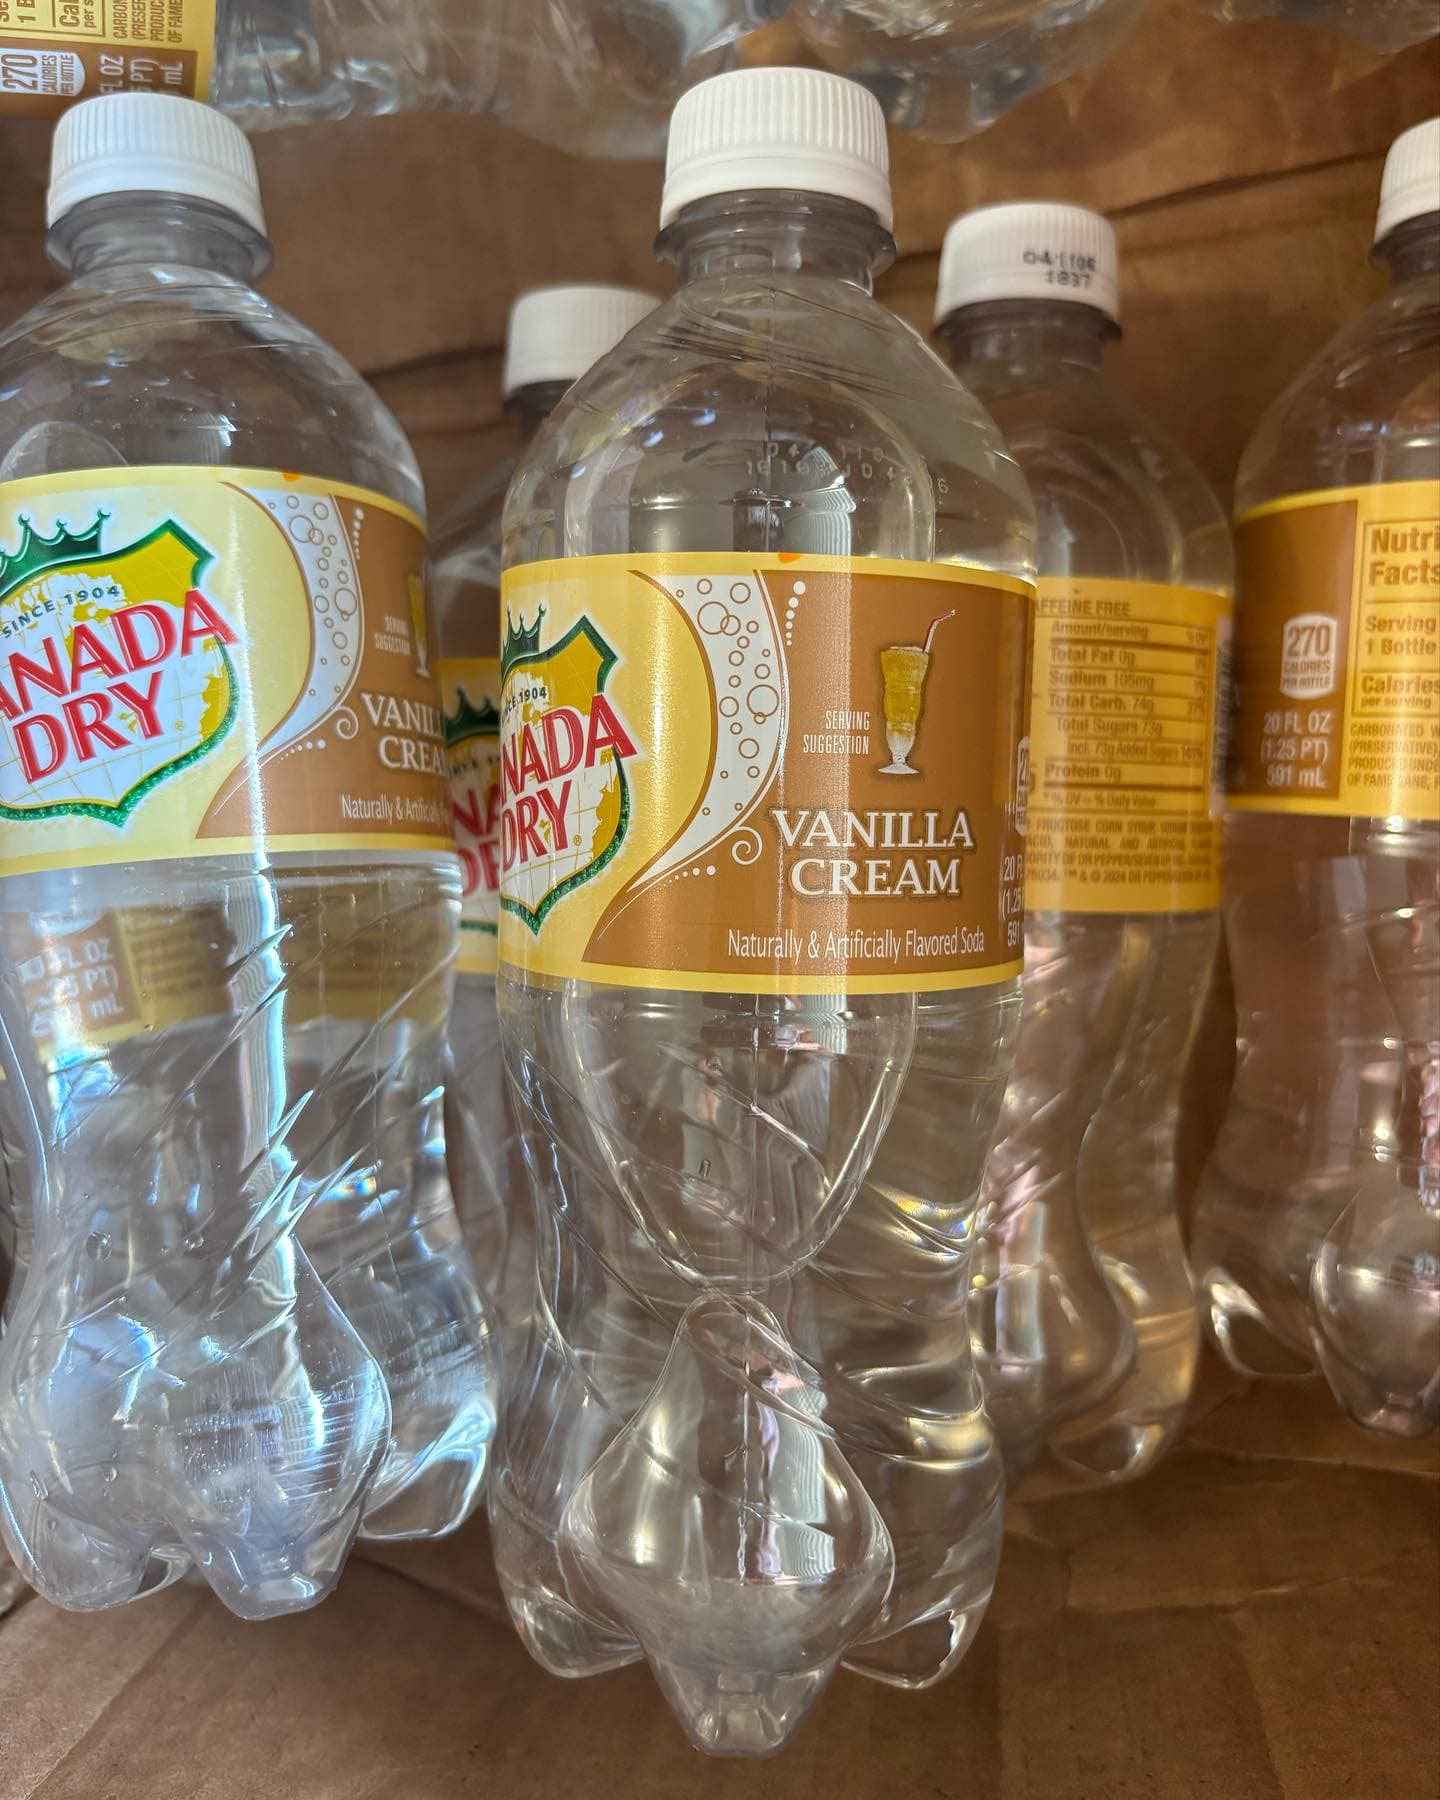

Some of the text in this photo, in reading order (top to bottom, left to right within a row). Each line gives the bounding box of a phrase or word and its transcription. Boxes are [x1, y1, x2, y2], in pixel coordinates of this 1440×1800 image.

[84, 9, 98, 29] per
[167, 29, 183, 43] OF
[1, 53, 38, 91] 270
[41, 55, 57, 93] CALORIES
[60, 54, 74, 95] PER BOTTLE
[100, 54, 124, 76] OZ
[129, 57, 159, 83] PT)
[161, 61, 183, 85] mL
[1045, 270, 1092, 289] 1837
[2, 584, 121, 639] SINCE 1904
[1095, 600, 1131, 618] FREE
[1051, 621, 1149, 642] Amount/serving
[1365, 615, 1437, 637] Serving
[1286, 624, 1331, 658] 270
[1365, 638, 1437, 657] 1 Bottle
[1050, 647, 1135, 667] Total Fat 0g
[1283, 659, 1331, 675] CALORIES
[1050, 670, 1107, 686] Sodium
[519, 687, 547, 703] 1904
[1050, 694, 1086, 708] Total
[1089, 694, 1127, 711] Carb.
[1361, 695, 1432, 709] per serving
[12, 670, 165, 785] DRY
[825, 710, 870, 732] SERVING
[1056, 717, 1088, 732] Total
[1092, 718, 1139, 736] Sugars
[1263, 711, 1332, 734] 20 FL OZ
[1350, 721, 1425, 737] CARBONATED
[802, 733, 870, 756] SUGGESTION
[1116, 743, 1148, 756] Added
[1260, 736, 1329, 764] (1.25 PT)
[1044, 763, 1100, 779] Protein
[1104, 764, 1122, 782] 0g
[1266, 765, 1327, 788] 591 mL
[1346, 771, 1361, 786] OF
[341, 794, 393, 825] Naturally
[396, 795, 403, 821] &
[1106, 794, 1131, 809] Daily
[501, 779, 574, 873] DRY
[771, 810, 975, 849] VANILLA
[1036, 817, 1090, 833] FRUCTOSE
[1095, 819, 1123, 833] CORN
[1065, 836, 1110, 850] NATURAL
[790, 857, 961, 897] CREAM
[1003, 856, 1015, 881] 20
[727, 926, 985, 964] Naturally & Artificially Flavored Soda
[1007, 920, 1020, 948] 591
